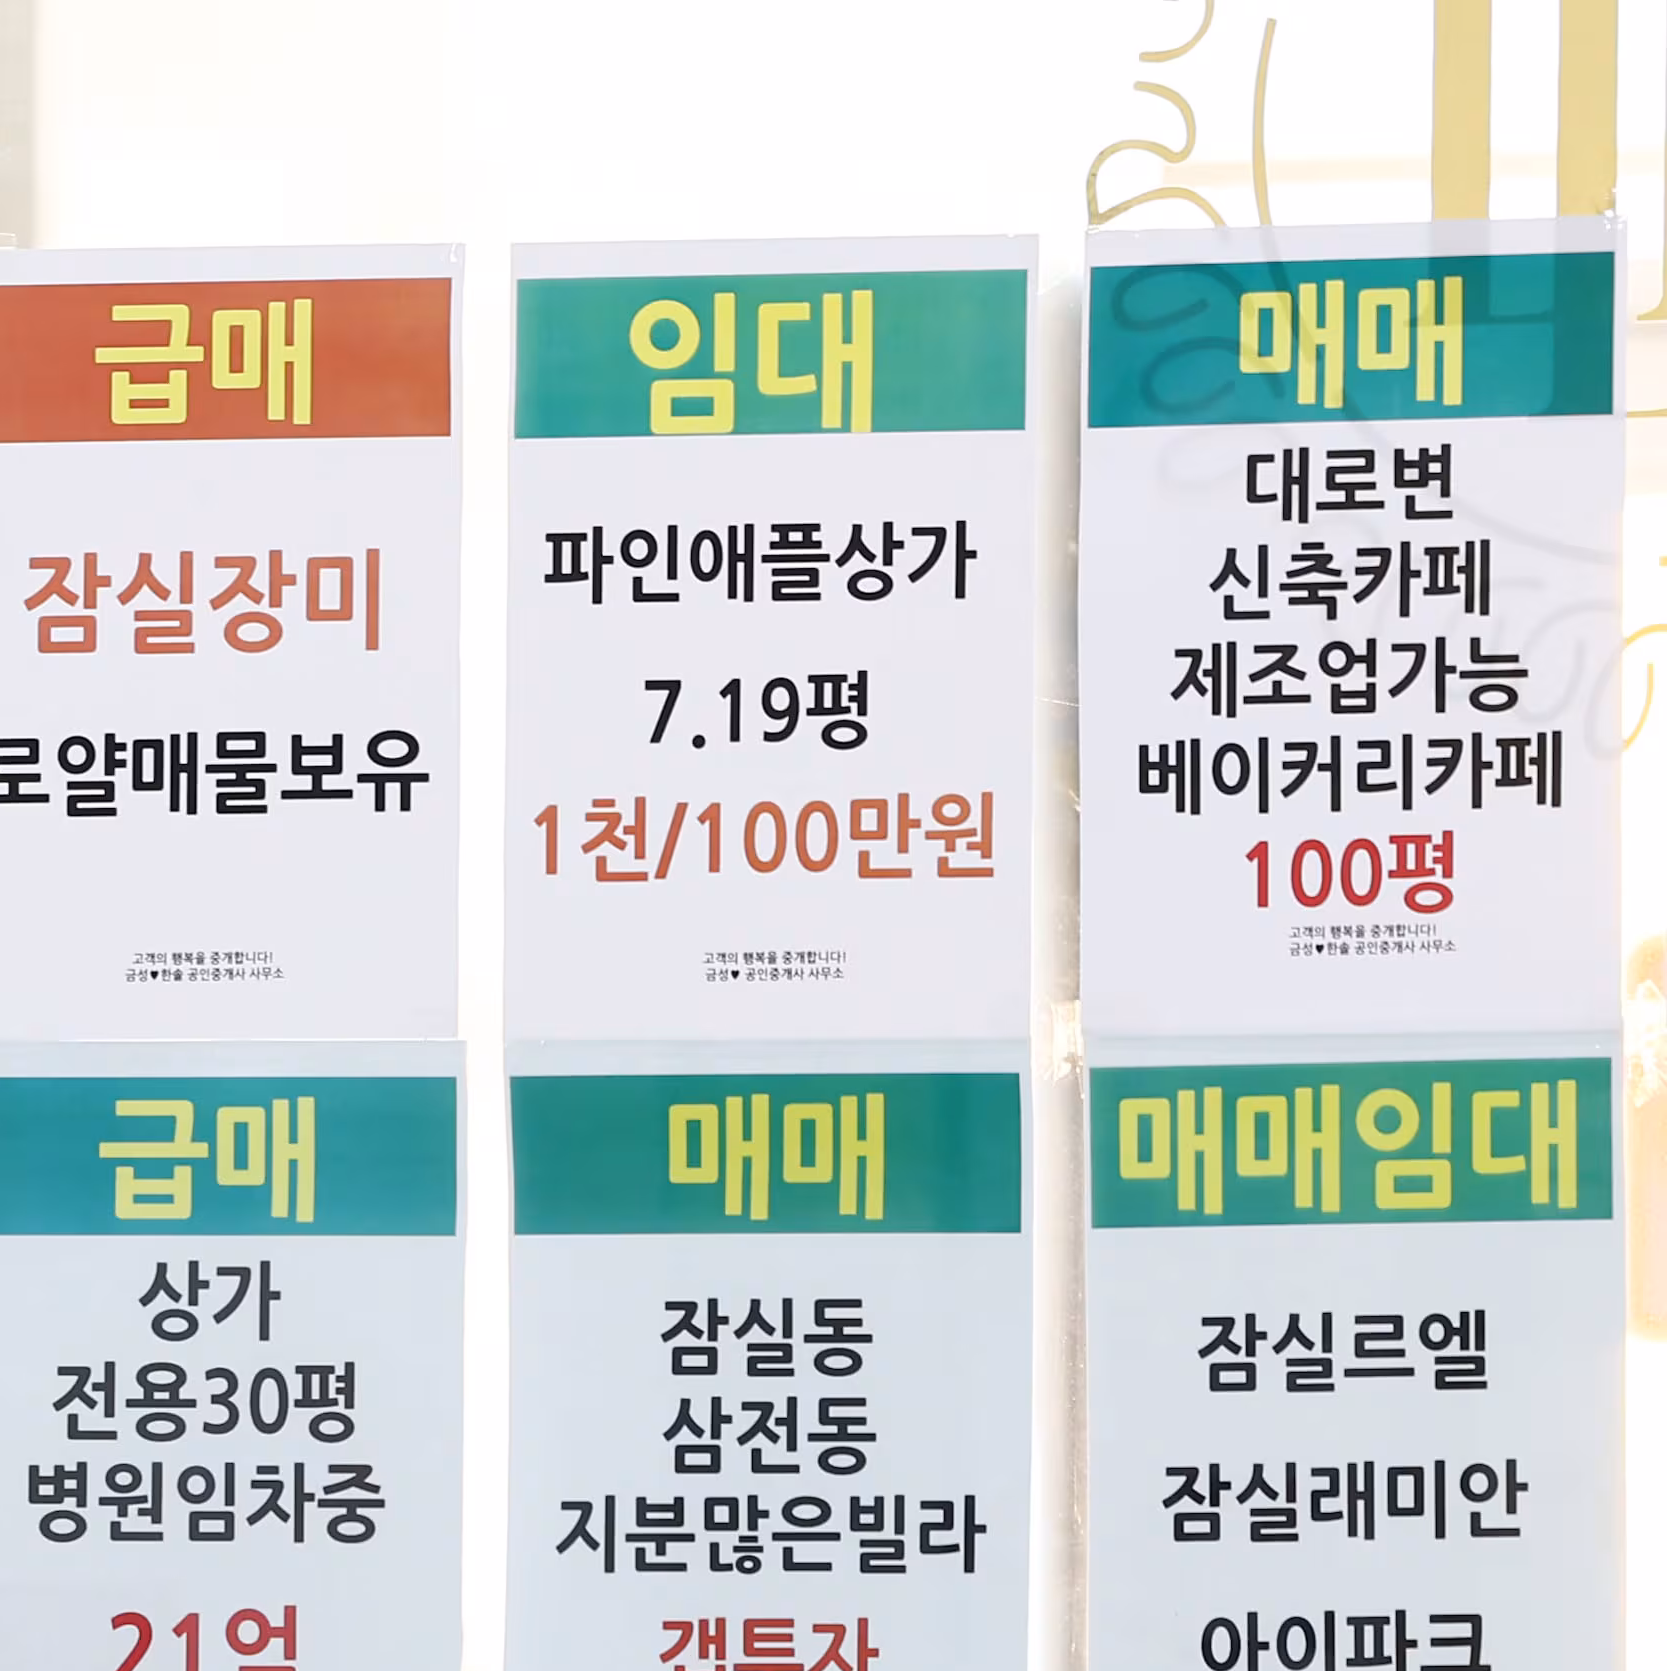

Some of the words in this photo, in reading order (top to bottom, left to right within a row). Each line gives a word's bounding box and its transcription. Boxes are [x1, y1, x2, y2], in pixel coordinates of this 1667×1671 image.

[95, 299, 311, 424] 급매
[629, 292, 875, 434] 임대
[1238, 274, 1464, 409] 매매
[1247, 444, 1453, 523] 대로변
[24, 549, 379, 654] 잠실장미
[543, 518, 979, 606] 파인애플상가
[1210, 539, 1490, 620] 신축카페
[645, 671, 867, 750] 7.19평
[1171, 637, 1528, 718] 제조업가능
[1139, 731, 1561, 815] 베이커리카페
[534, 792, 994, 882] 1천/100만원
[1246, 830, 1453, 914] 100평
[99, 1097, 315, 1222] 급매
[669, 1094, 884, 1220] 매매
[1120, 1080, 1577, 1214] 매매임대
[139, 1261, 281, 1341] 상가
[661, 1298, 872, 1376] 잠실동
[1198, 1310, 1487, 1392] 잠실르엘
[53, 1361, 354, 1443] 전용30평
[663, 1397, 876, 1475] 삼전동
[29, 1462, 385, 1543] 병원임차중
[556, 1495, 986, 1574] 지분많은빌라
[1163, 1459, 1528, 1542] 잠실래미안
